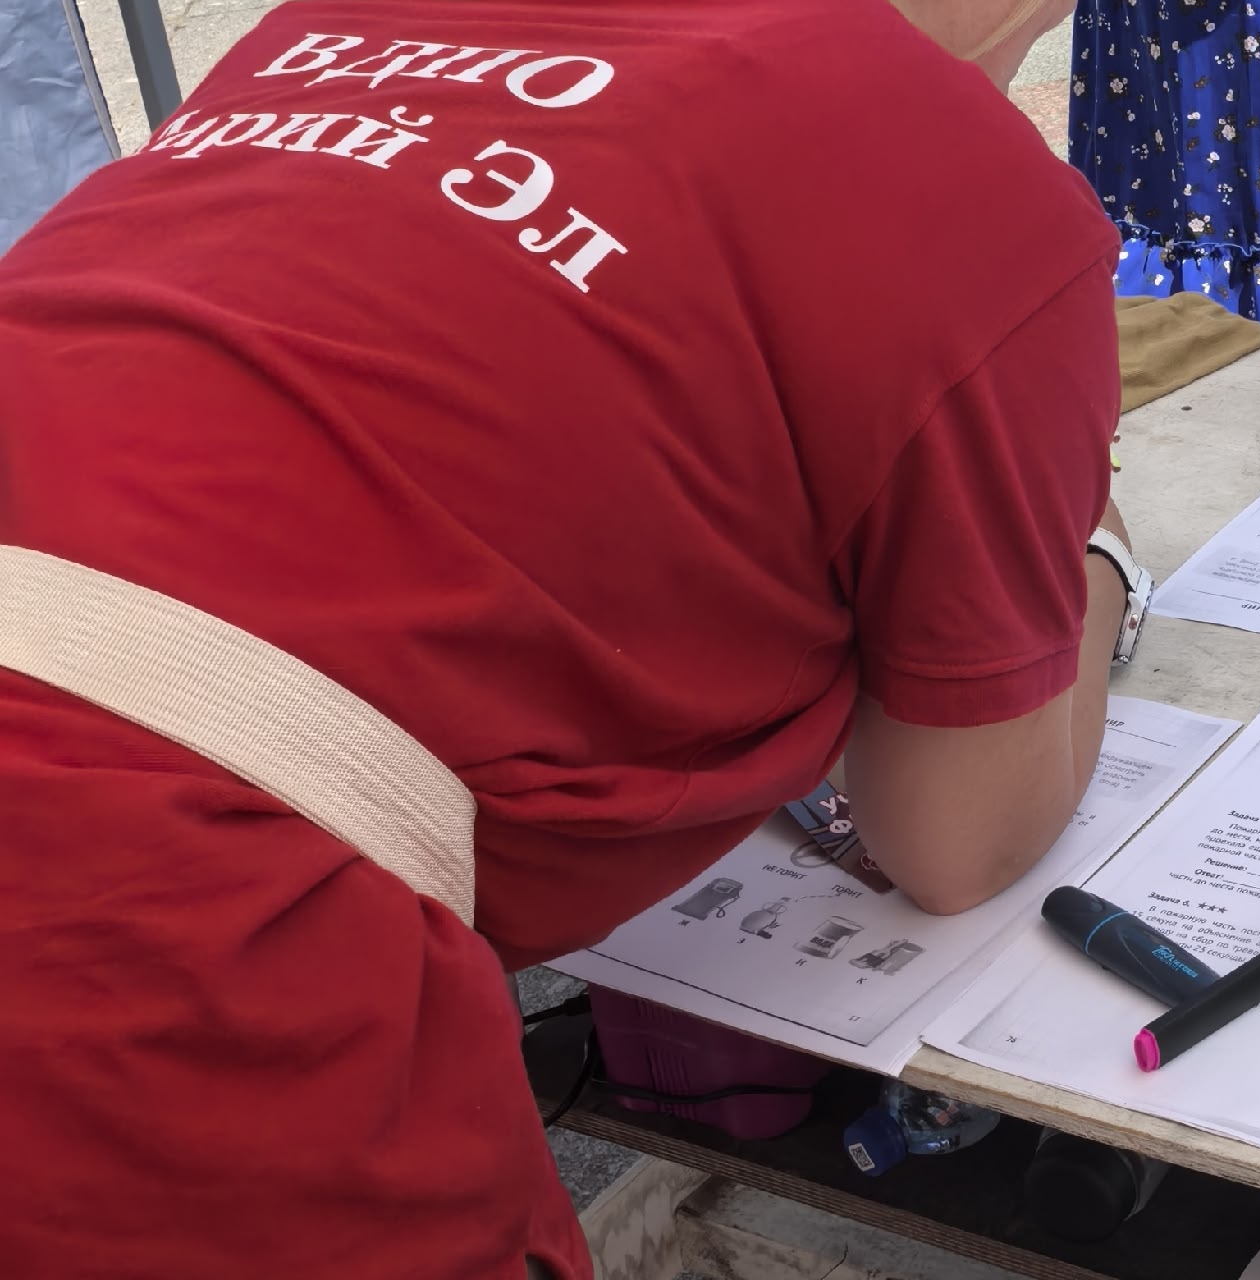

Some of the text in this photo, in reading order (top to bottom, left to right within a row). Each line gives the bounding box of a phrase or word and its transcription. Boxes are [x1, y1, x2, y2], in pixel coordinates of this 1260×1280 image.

[254, 32, 615, 109] ВДПО
[1227, 810, 1260, 822] Задача
[1197, 842, 1242, 856] пожарной
[1204, 857, 1247, 871] Решение:
[776, 867, 807, 880] ГОРИТ
[1169, 872, 1193, 882] части
[1209, 881, 1235, 890] места
[831, 884, 863, 898] ГОРИТ
[1147, 891, 1180, 904] Задача
[1159, 909, 1207, 924] пожарную
[1212, 921, 1236, 931] часть
[1181, 923, 1194, 931] на
[1197, 927, 1252, 944] объяснение
[1191, 935, 1214, 944] сбор
[1216, 941, 1229, 949] по
[1192, 944, 1206, 953] 25
